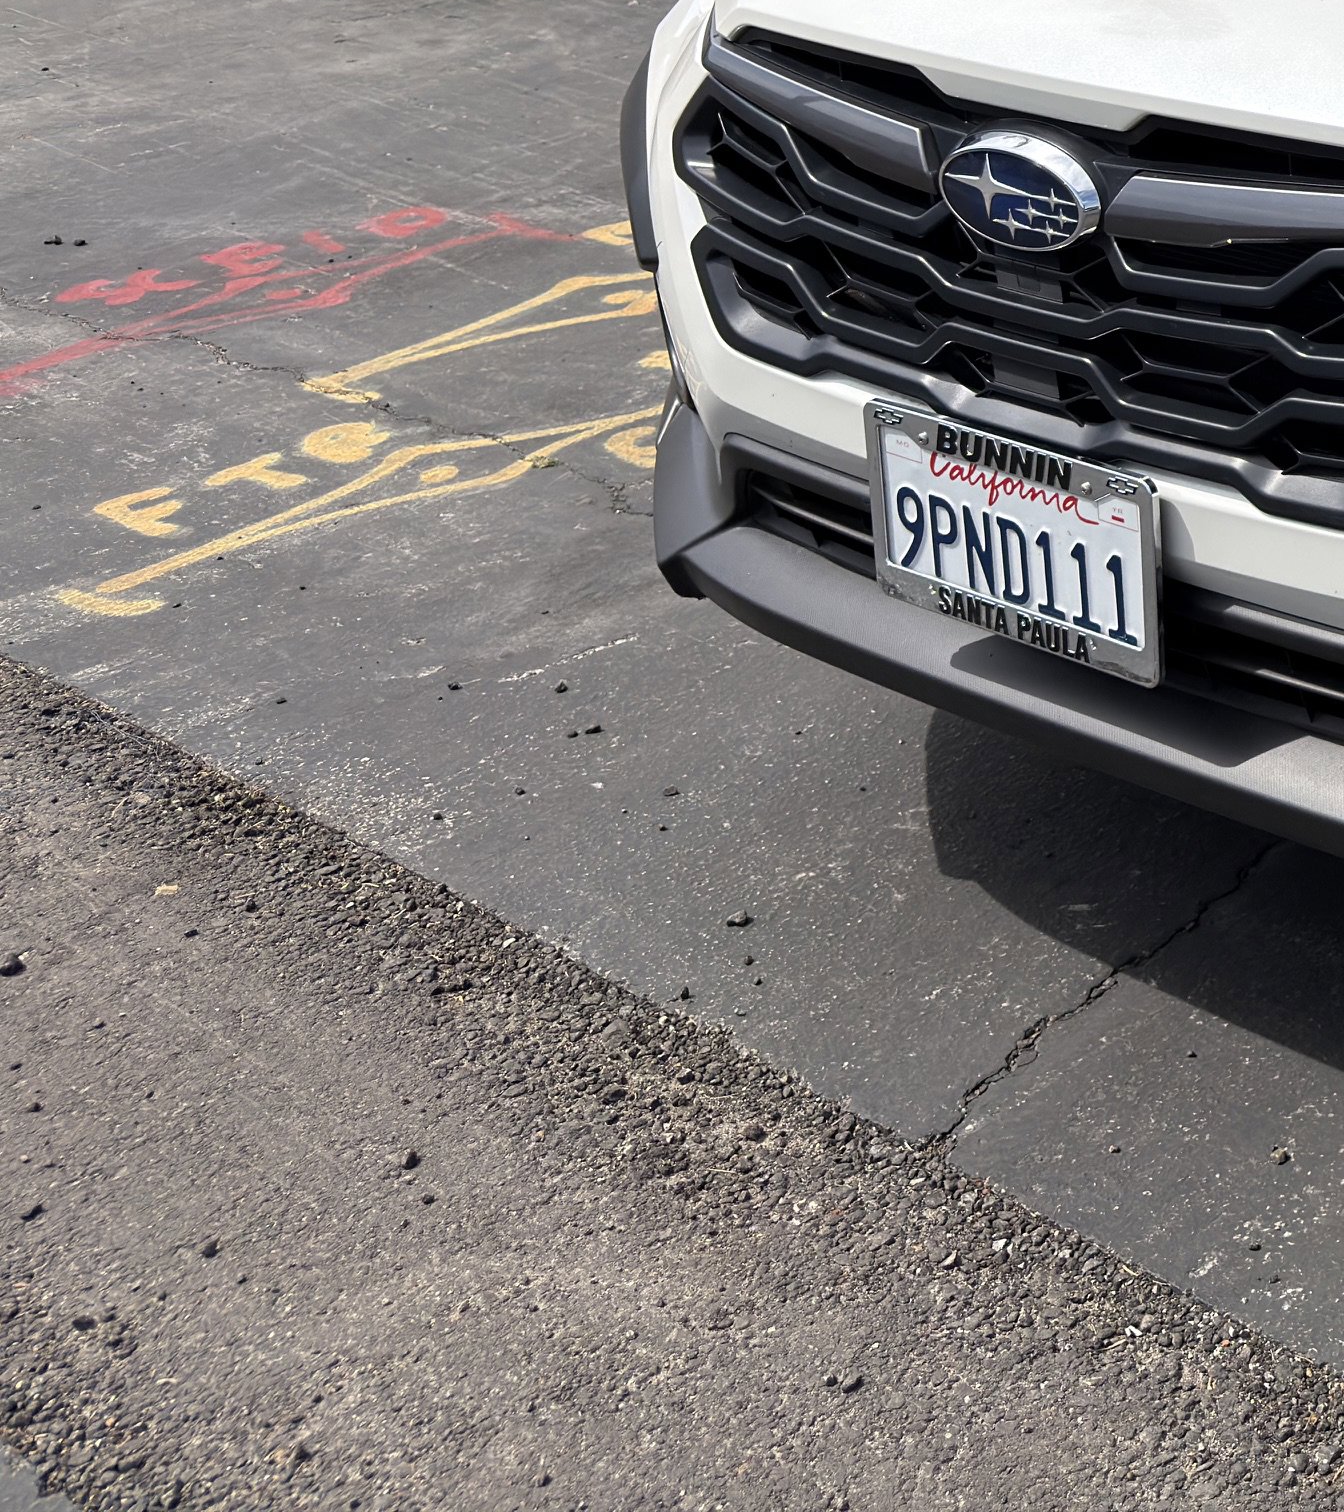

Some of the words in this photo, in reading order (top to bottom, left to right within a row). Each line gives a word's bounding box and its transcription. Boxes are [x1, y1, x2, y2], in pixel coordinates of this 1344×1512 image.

[929, 450, 1100, 525] California
[936, 423, 1073, 491] BUNNIN
[896, 485, 1138, 647] 9PND111
[938, 586, 1010, 636] SANTA
[1016, 609, 1091, 663] PAULA
